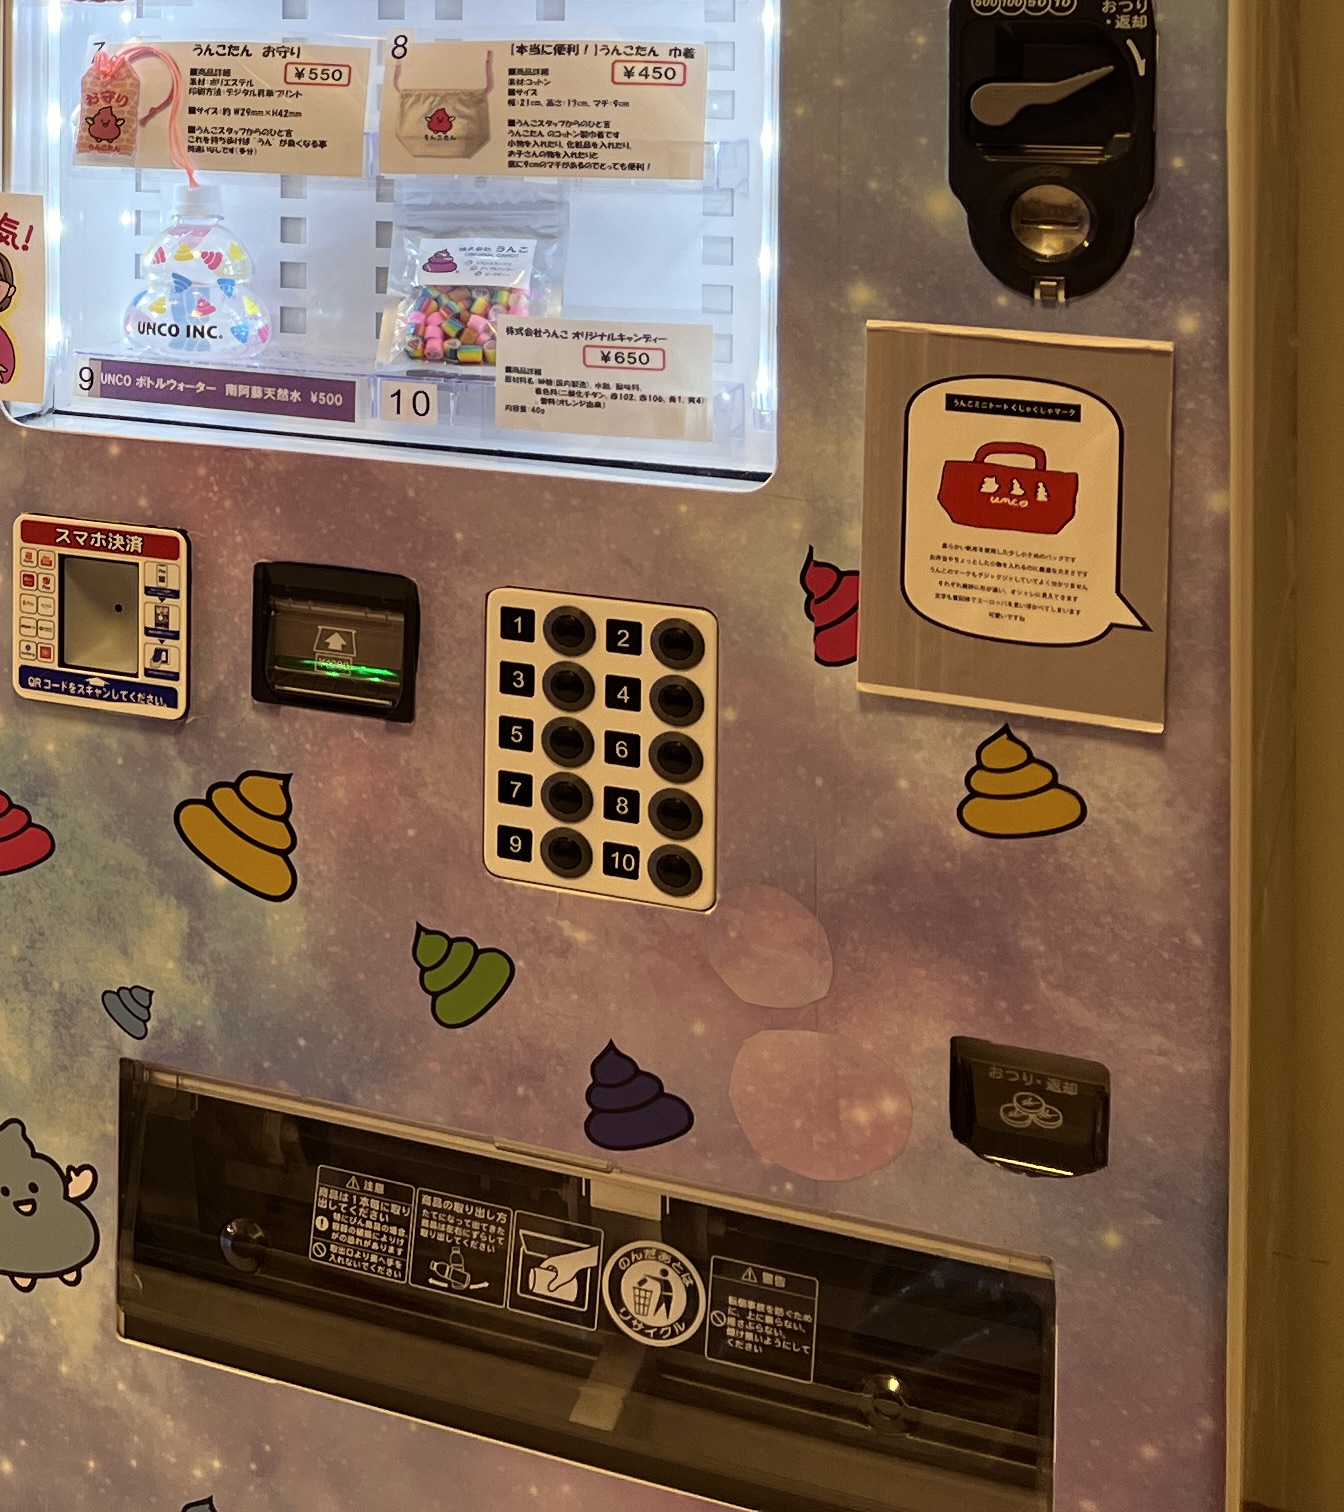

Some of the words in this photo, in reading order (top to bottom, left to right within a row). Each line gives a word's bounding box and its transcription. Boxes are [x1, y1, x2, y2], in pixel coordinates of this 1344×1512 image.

[193, 43, 252, 57] うんこたん
[262, 45, 301, 59] お守り
[391, 35, 408, 59] 8
[669, 46, 696, 59] 巾着
[86, 90, 129, 107] お守り
[137, 320, 180, 337] UNCO
[185, 324, 223, 339] INC.
[506, 325, 568, 339] 株式会社うんこ
[572, 331, 668, 344] オリジナルキャンディー
[78, 367, 94, 391] 9
[101, 372, 132, 388] UNCO
[135, 375, 216, 393] ボトルウォーター
[390, 389, 430, 417] 10
[55, 528, 144, 554] スマホ決済
[514, 617, 522, 634] 1
[617, 629, 629, 647] 2
[616, 685, 629, 703] 4
[511, 726, 523, 743] 5
[611, 851, 635, 871] 10
[317, 1196, 389, 1222] 出してください
[421, 1194, 508, 1224] 商品の取り出し方
[618, 1247, 695, 1289] のんだあとは
[619, 1306, 686, 1340] リサイクル
